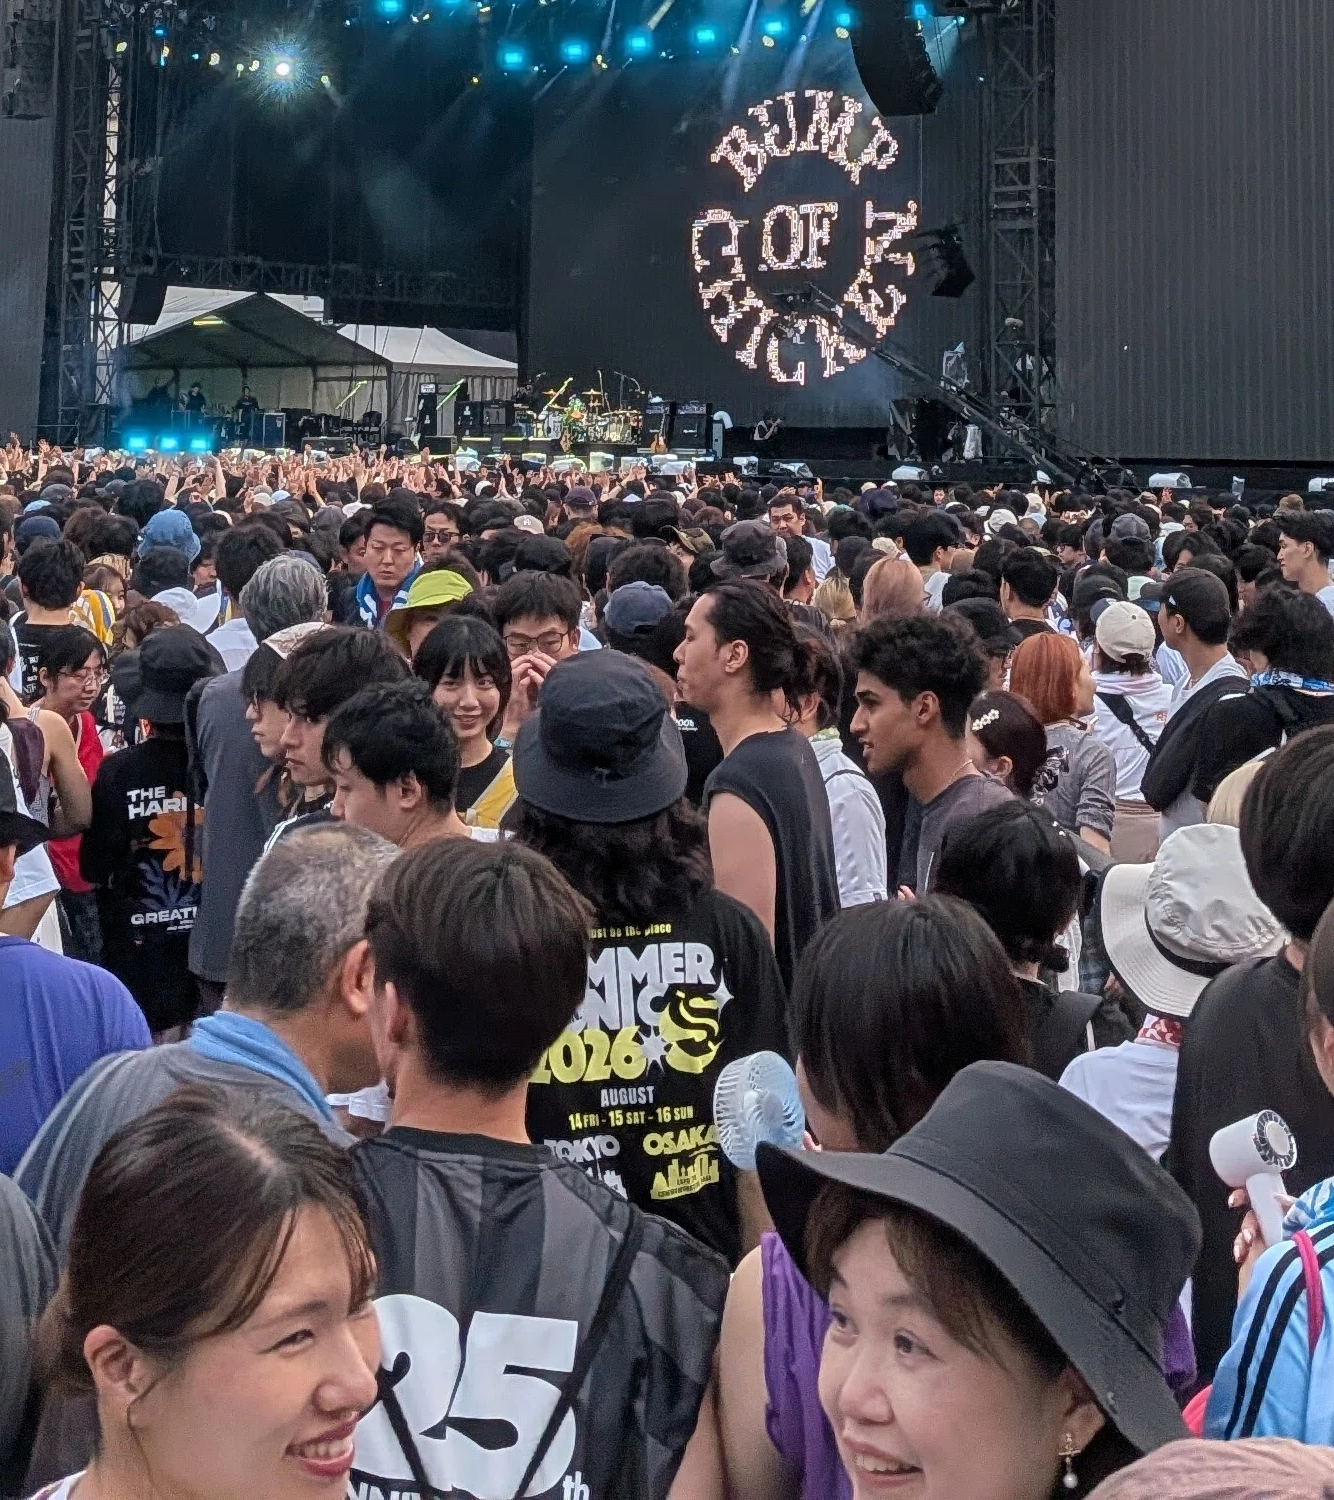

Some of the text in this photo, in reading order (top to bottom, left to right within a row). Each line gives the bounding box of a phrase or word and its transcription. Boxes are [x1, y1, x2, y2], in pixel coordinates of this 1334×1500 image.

[710, 90, 899, 192] BUMP
[758, 202, 839, 271] OF
[126, 785, 166, 803] THE
[644, 923, 672, 937] place
[600, 1086, 655, 1108] AUGUST
[568, 1112, 583, 1131] 14
[583, 1113, 600, 1128] FRI
[608, 1110, 624, 1128] 15
[626, 1111, 646, 1125] SAT
[655, 1106, 672, 1123] 16
[673, 1106, 694, 1121] SUN
[543, 1124, 722, 1164] TOKYO OSAKA
[351, 1293, 579, 1500] 25
